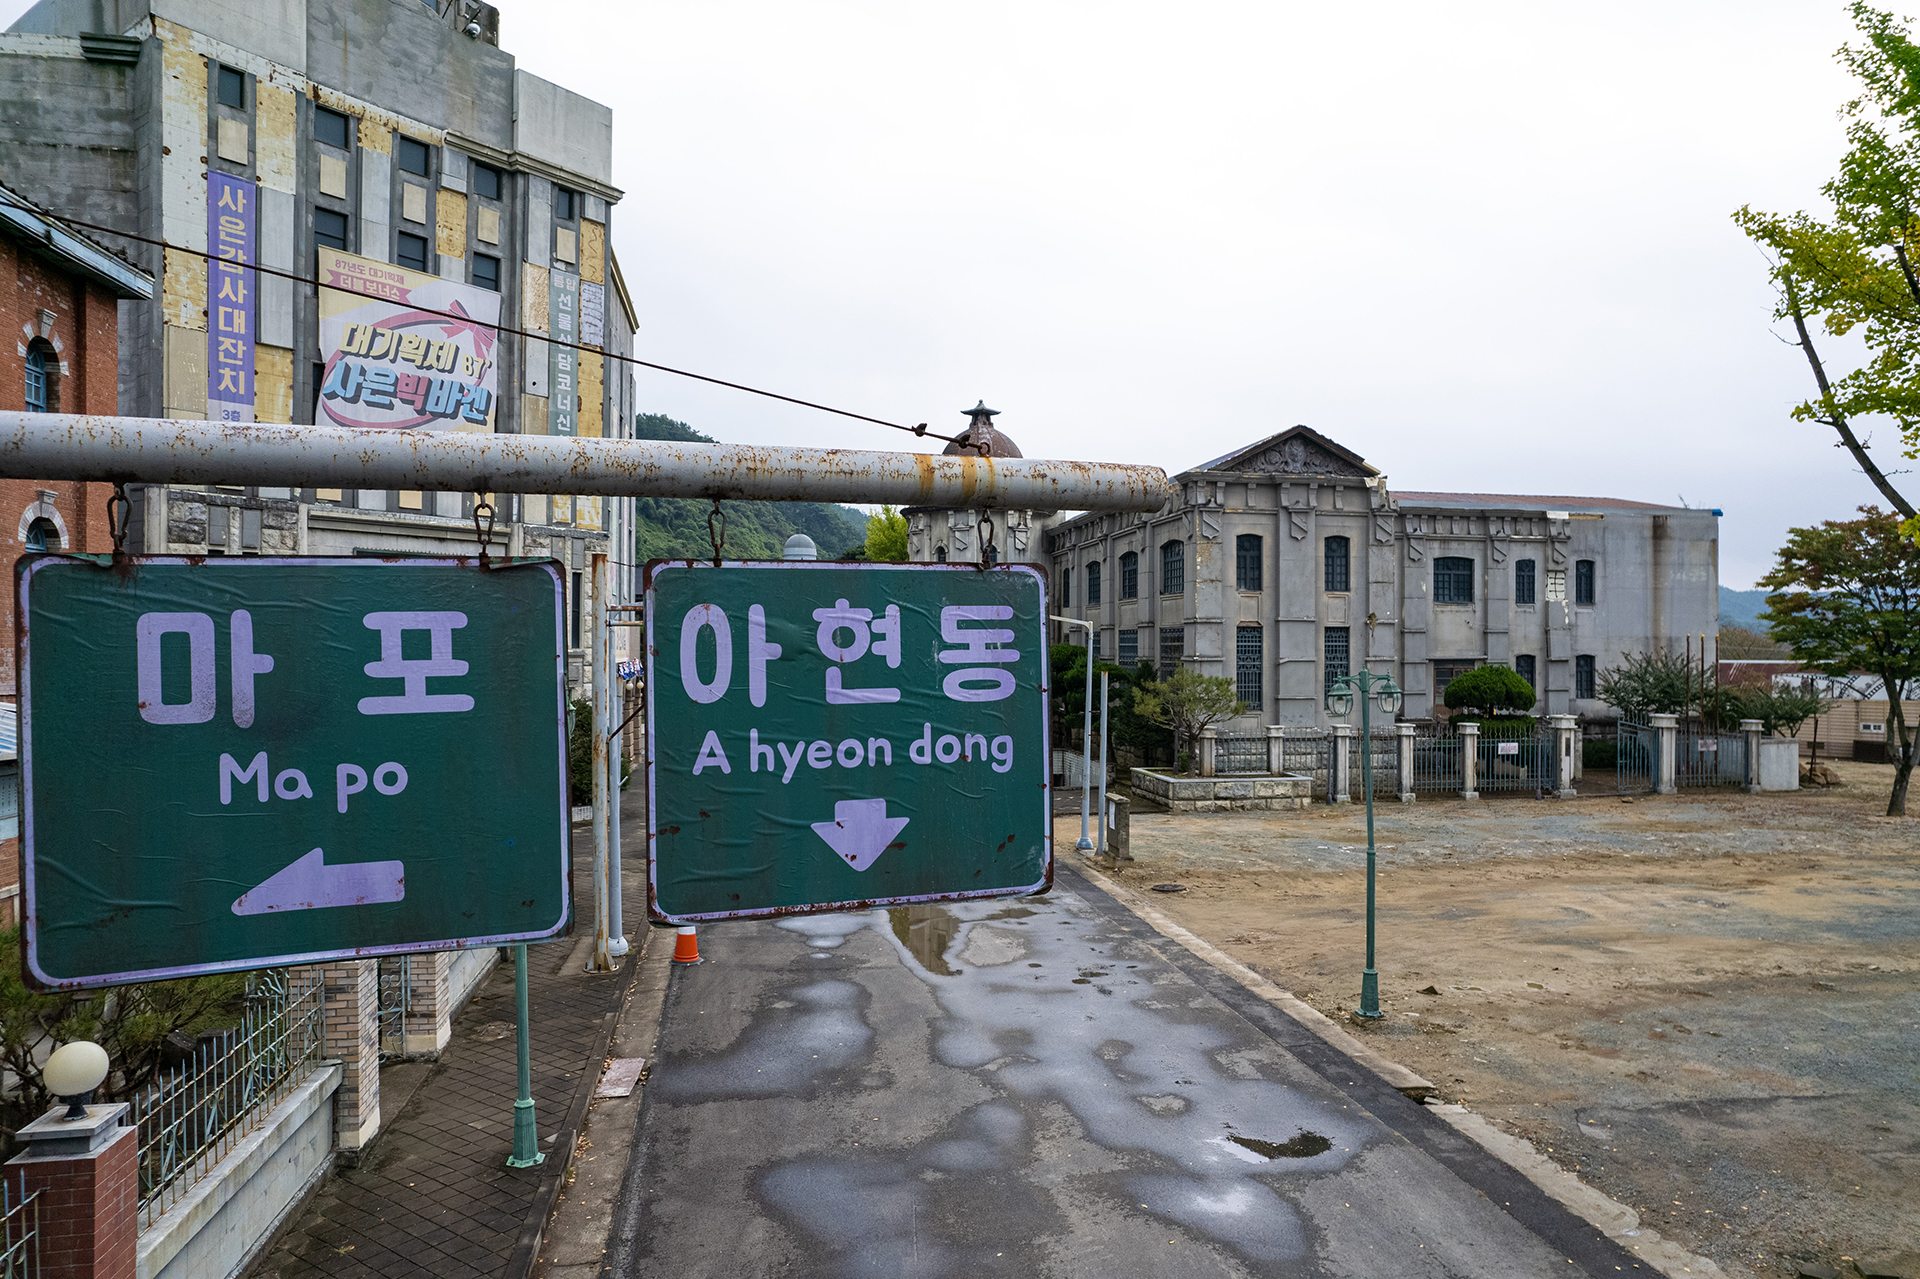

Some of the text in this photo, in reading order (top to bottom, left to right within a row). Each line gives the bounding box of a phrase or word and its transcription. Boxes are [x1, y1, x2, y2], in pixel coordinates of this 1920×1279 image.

[217, 185, 248, 395] 사은감사대잔치
[335, 259, 366, 275] 87년도
[340, 275, 400, 300] 더블보너스
[338, 321, 459, 375] 대기획제
[222, 409, 241, 422] 3층
[692, 722, 1013, 784] A hyeon dong
[219, 751, 408, 813] Ma po
